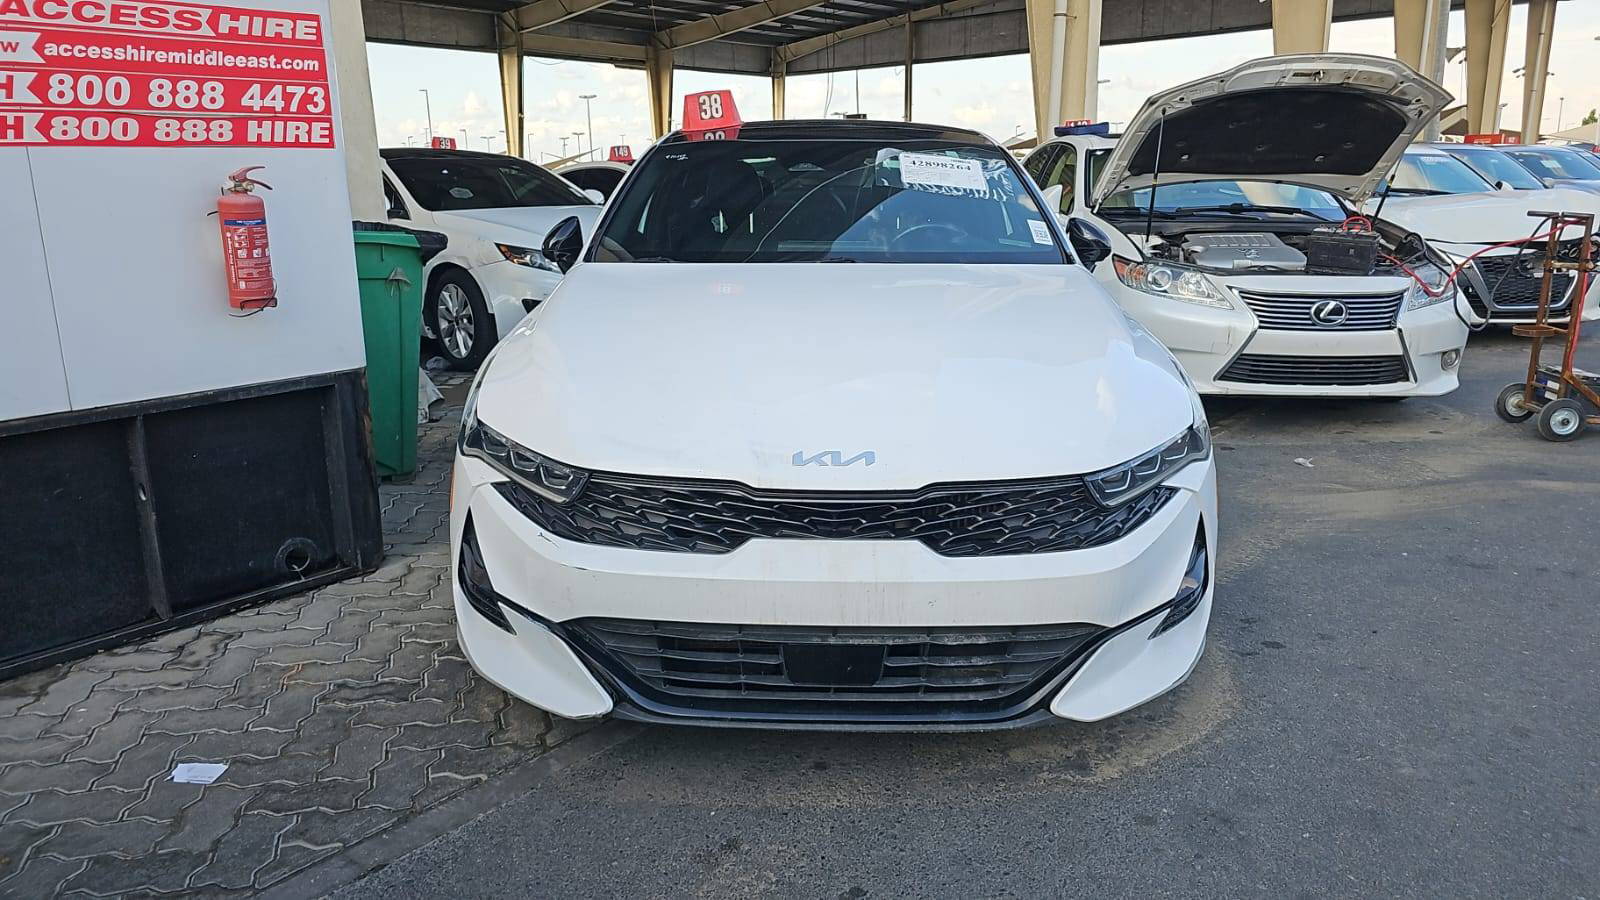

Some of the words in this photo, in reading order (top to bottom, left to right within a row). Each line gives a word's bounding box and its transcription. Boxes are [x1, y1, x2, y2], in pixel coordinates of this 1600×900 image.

[0, 0, 205, 31] ACCESS
[217, 13, 318, 40] HIRE
[43, 40, 320, 71] accesshiremiddleeast.com
[47, 73, 131, 106] 800
[148, 78, 225, 110] 888
[240, 83, 326, 114] 4473
[699, 93, 724, 120] 38
[49, 115, 140, 141] 800
[153, 117, 234, 143] 888
[246, 119, 331, 144] HIRE
[439, 137, 451, 150] 39
[911, 159, 972, 171] 42898264
[791, 450, 876, 467] KIA
